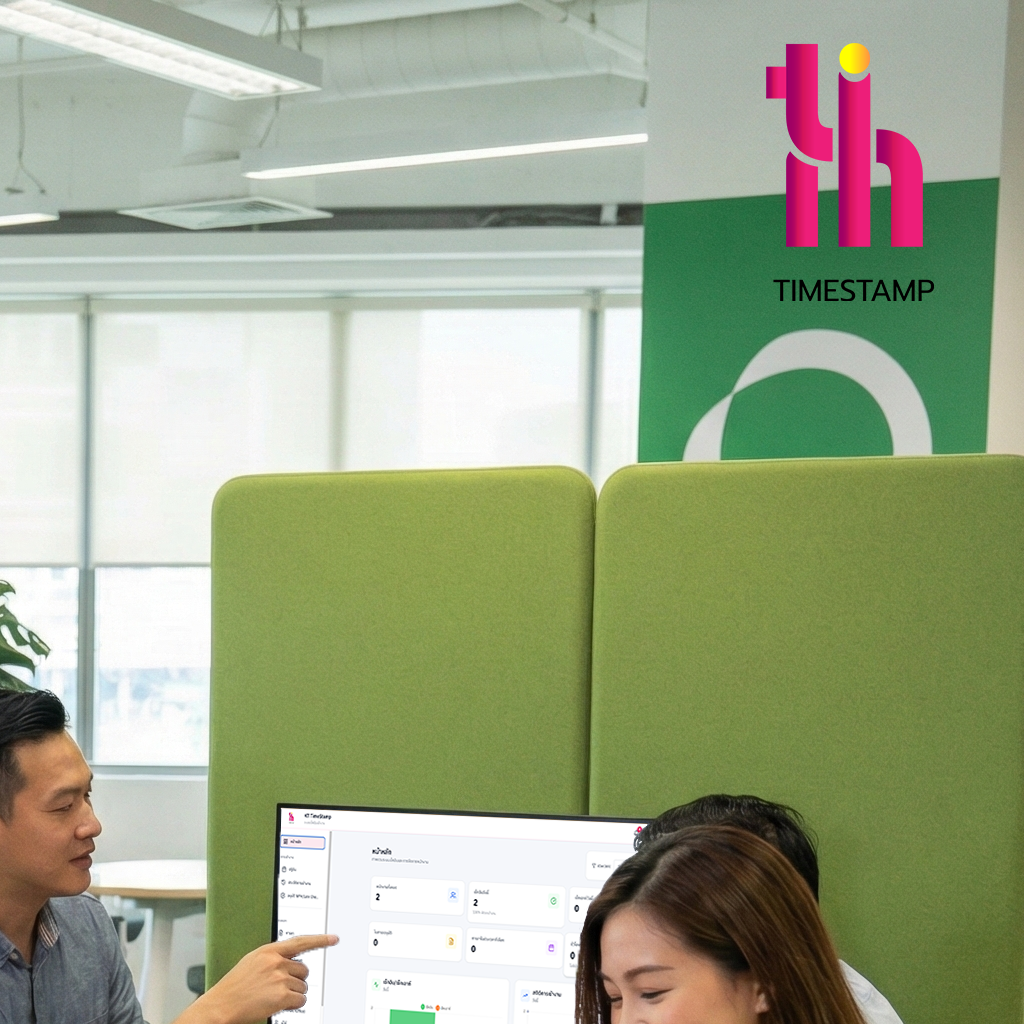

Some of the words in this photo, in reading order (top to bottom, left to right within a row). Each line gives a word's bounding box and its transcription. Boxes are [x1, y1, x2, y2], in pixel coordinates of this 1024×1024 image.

[375, 893, 380, 901] 2
[473, 898, 478, 907] 2
[574, 904, 580, 913] 0
[373, 938, 379, 946] 0
[470, 944, 476, 953] 0
[569, 951, 576, 960] 0
